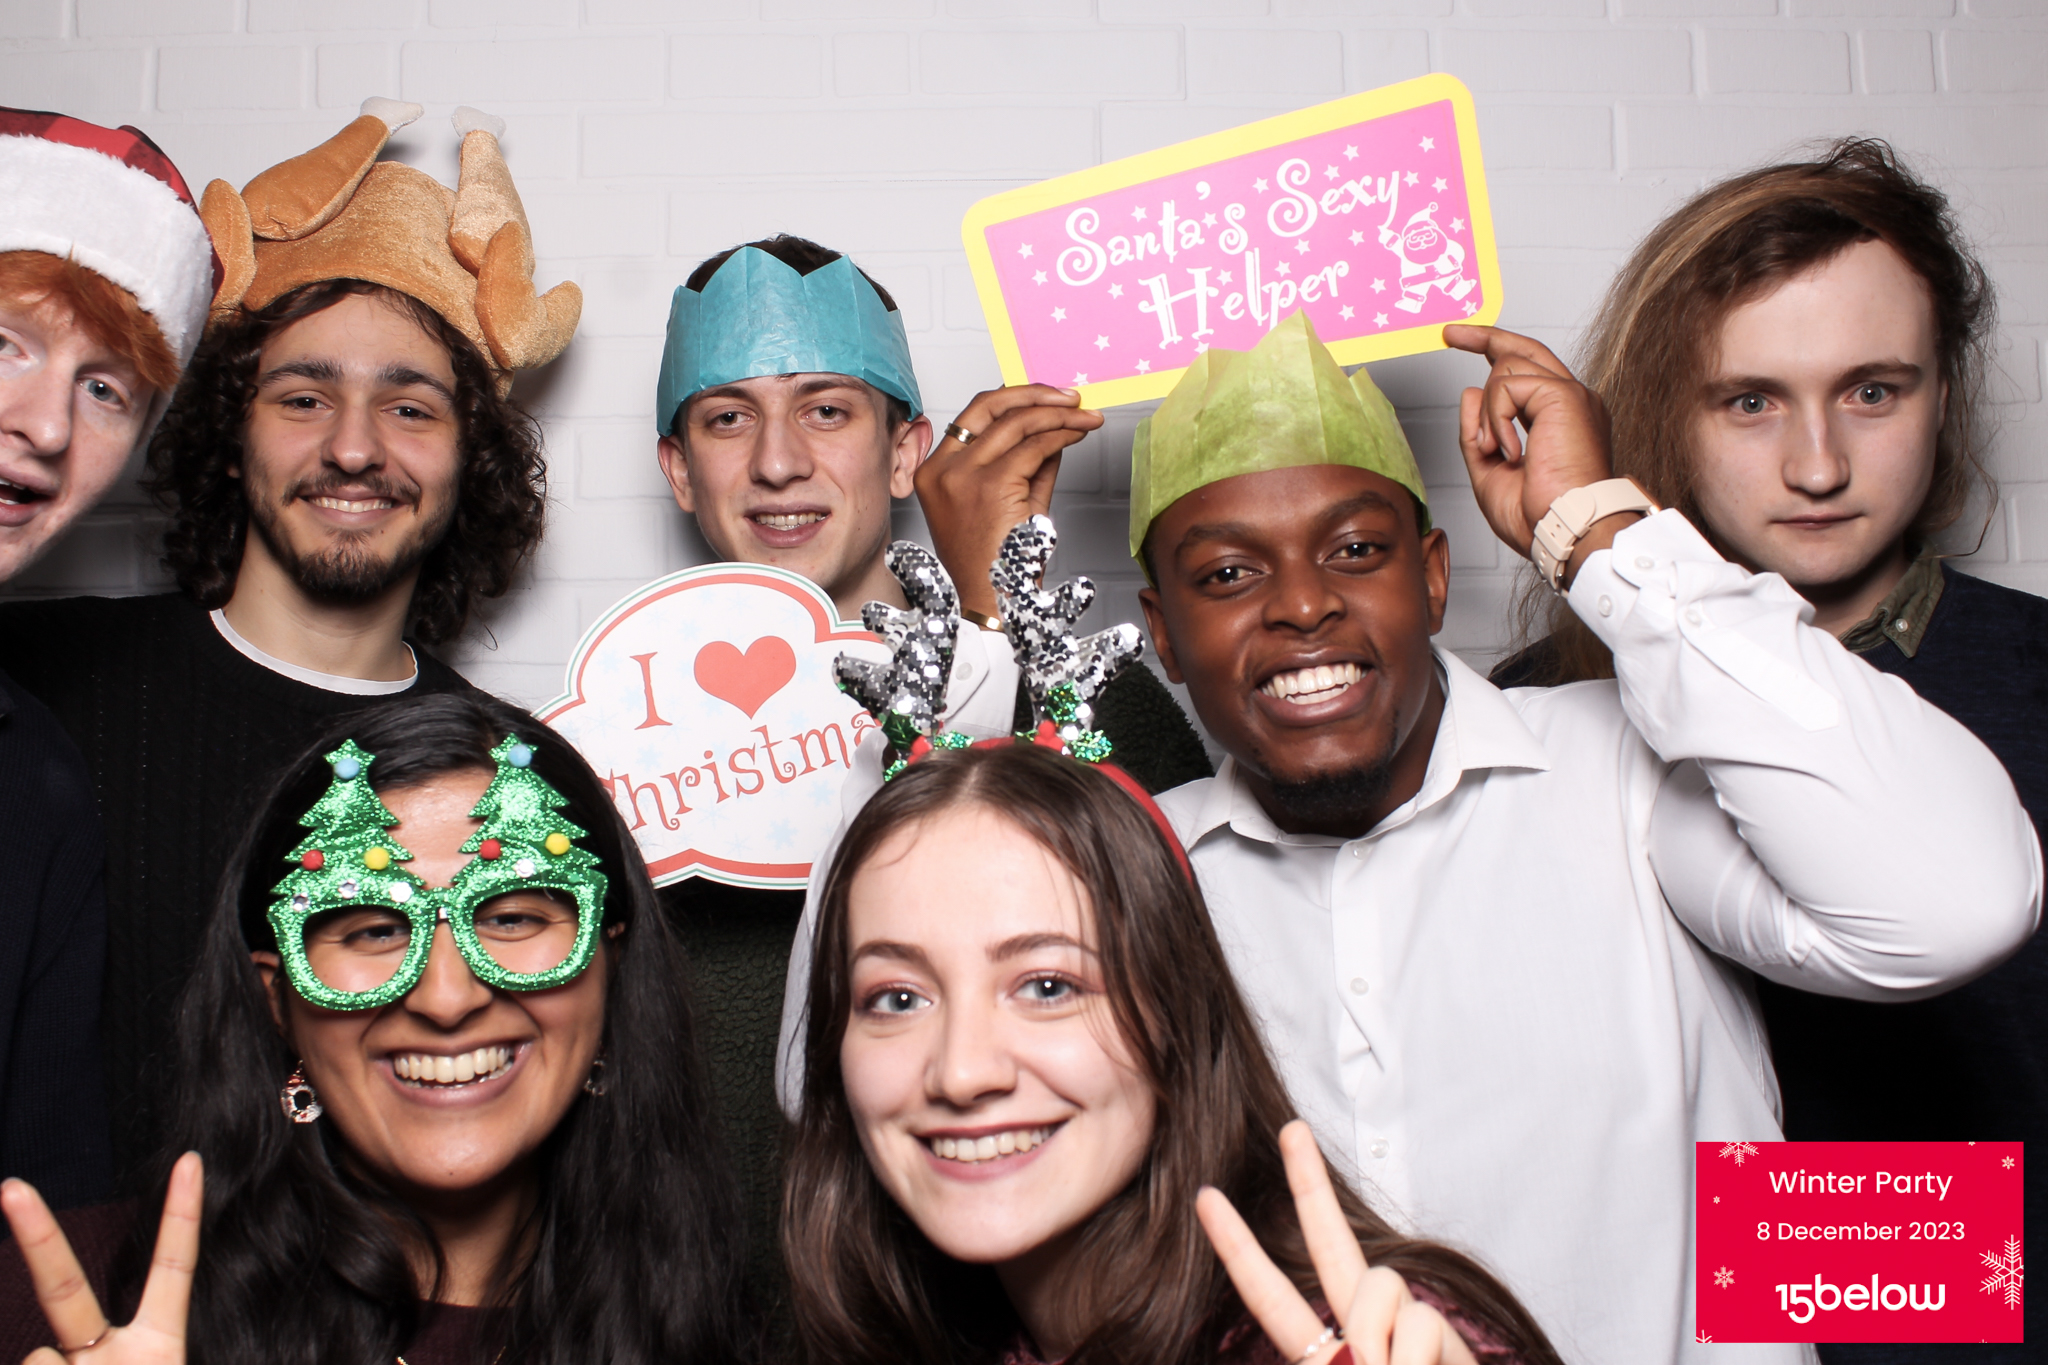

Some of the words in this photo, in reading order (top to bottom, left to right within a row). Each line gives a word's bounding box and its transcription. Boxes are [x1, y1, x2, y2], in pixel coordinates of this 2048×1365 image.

[1056, 180, 1249, 286] Santa's
[1266, 157, 1400, 238] Sexy
[1137, 246, 1350, 350] Helper
[629, 651, 673, 731] I
[597, 709, 884, 832] hristma
